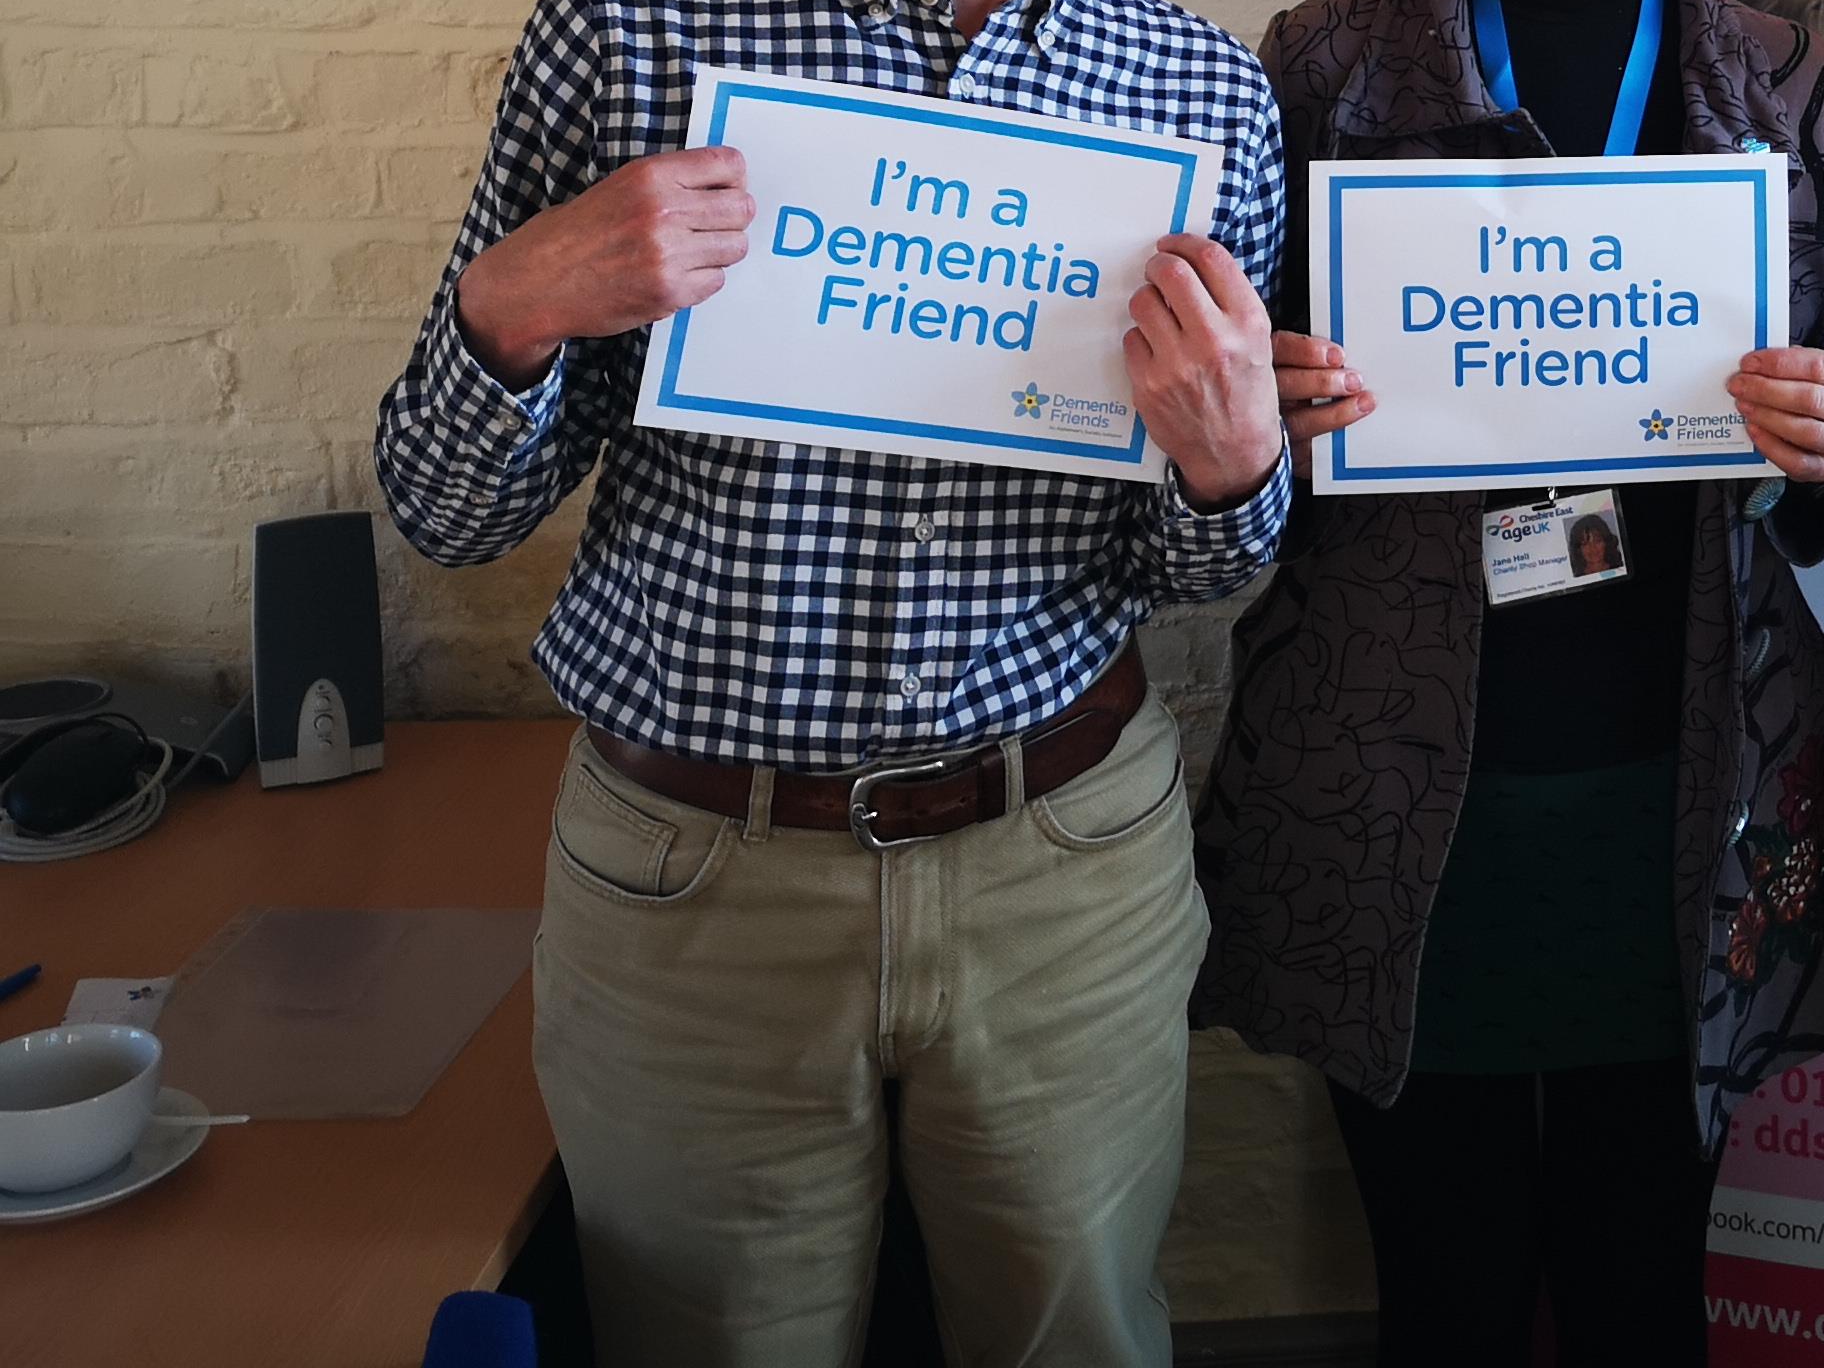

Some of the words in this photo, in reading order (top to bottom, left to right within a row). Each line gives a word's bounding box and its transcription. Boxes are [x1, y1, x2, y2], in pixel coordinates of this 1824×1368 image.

[868, 157, 971, 219] I'm
[990, 188, 1029, 229] a
[772, 205, 1101, 299] Dementia
[1479, 226, 1568, 274] I'm
[1589, 233, 1623, 273] a
[816, 275, 1038, 352] Friend
[1401, 278, 1699, 333] Dementia
[1453, 336, 1650, 388] Friend
[1050, 409, 1110, 429] Friends
[1052, 393, 1128, 416] Dementia
[1677, 412, 1746, 427] Dementia
[1676, 426, 1732, 440] Friends
[1555, 507, 1574, 517] East
